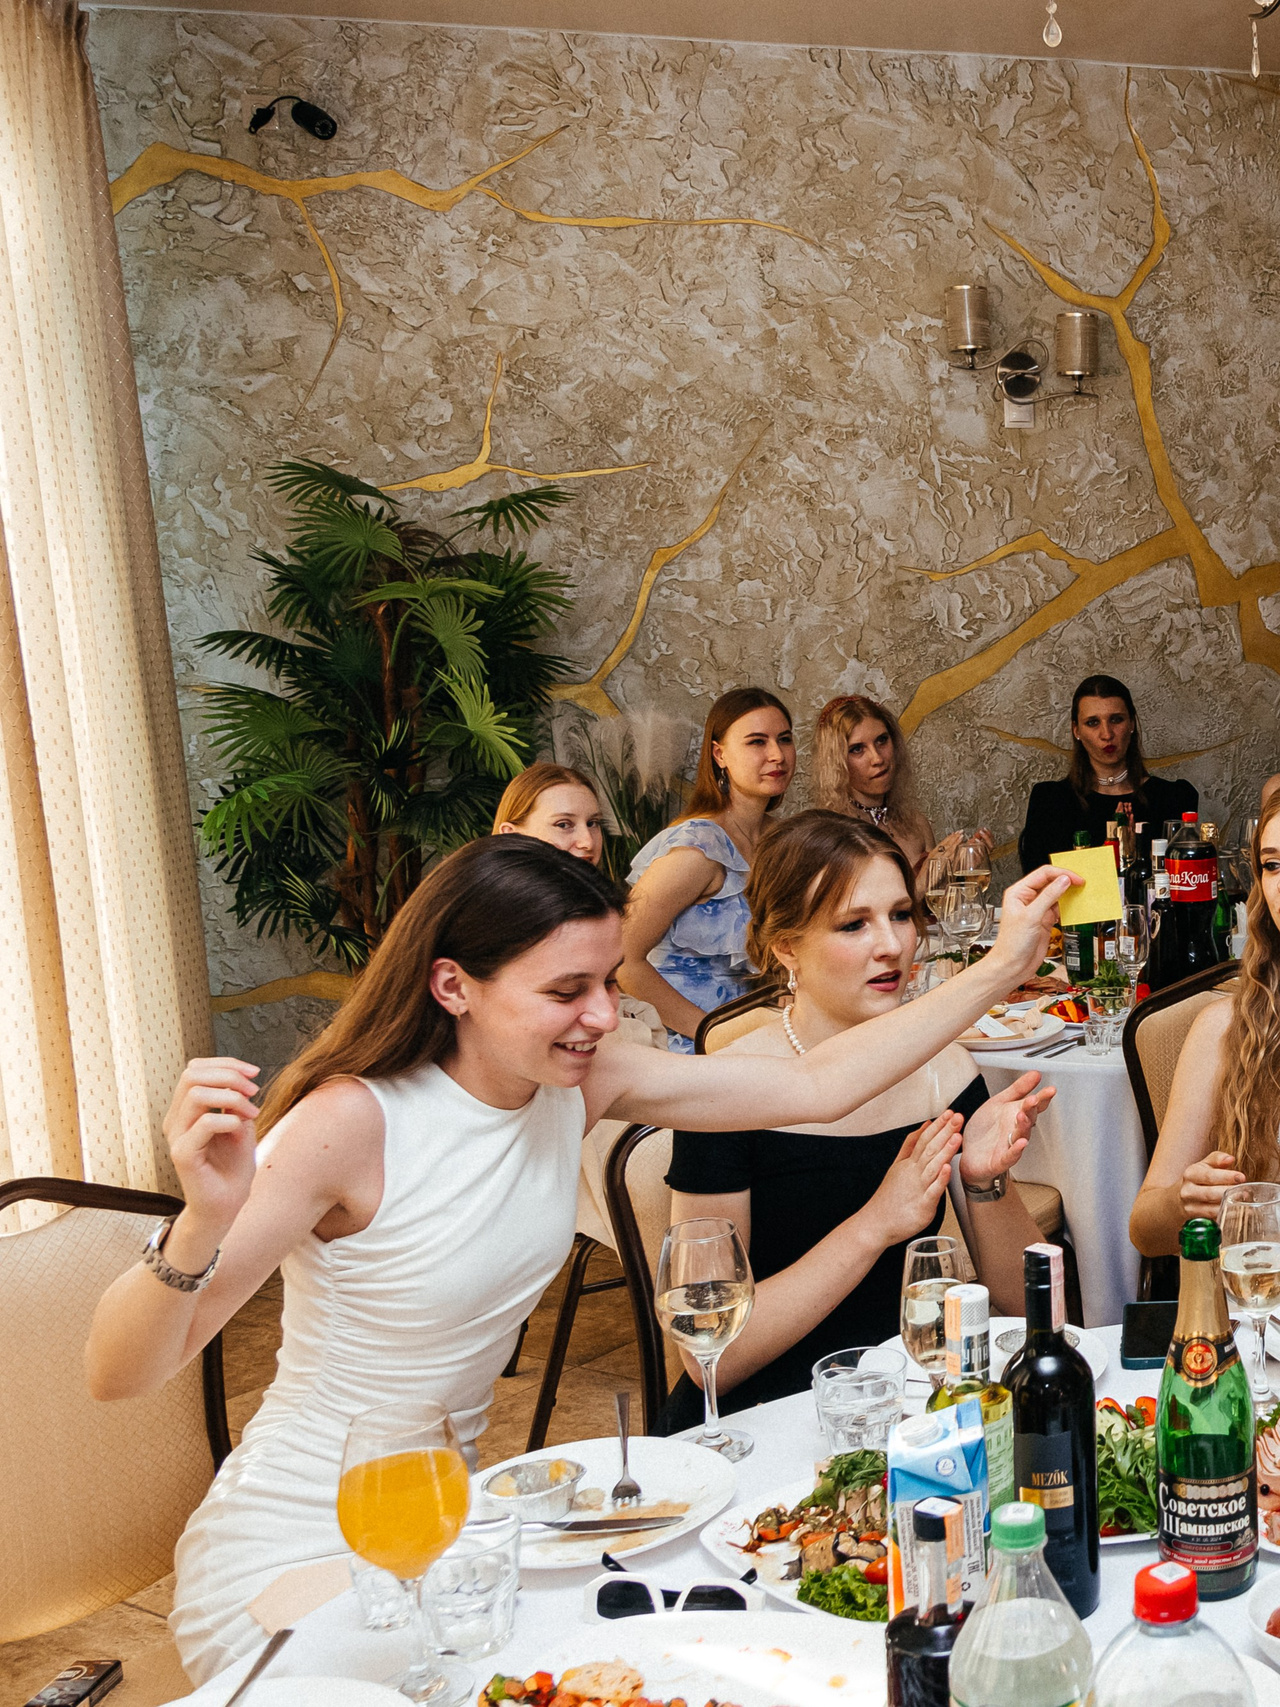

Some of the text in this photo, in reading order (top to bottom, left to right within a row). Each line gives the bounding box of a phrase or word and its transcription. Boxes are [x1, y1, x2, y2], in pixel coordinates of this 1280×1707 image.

[1169, 871, 1209, 887] ла-Кола
[1159, 1482, 1247, 1518] Советское
[1162, 1511, 1250, 1537] Шампанское
